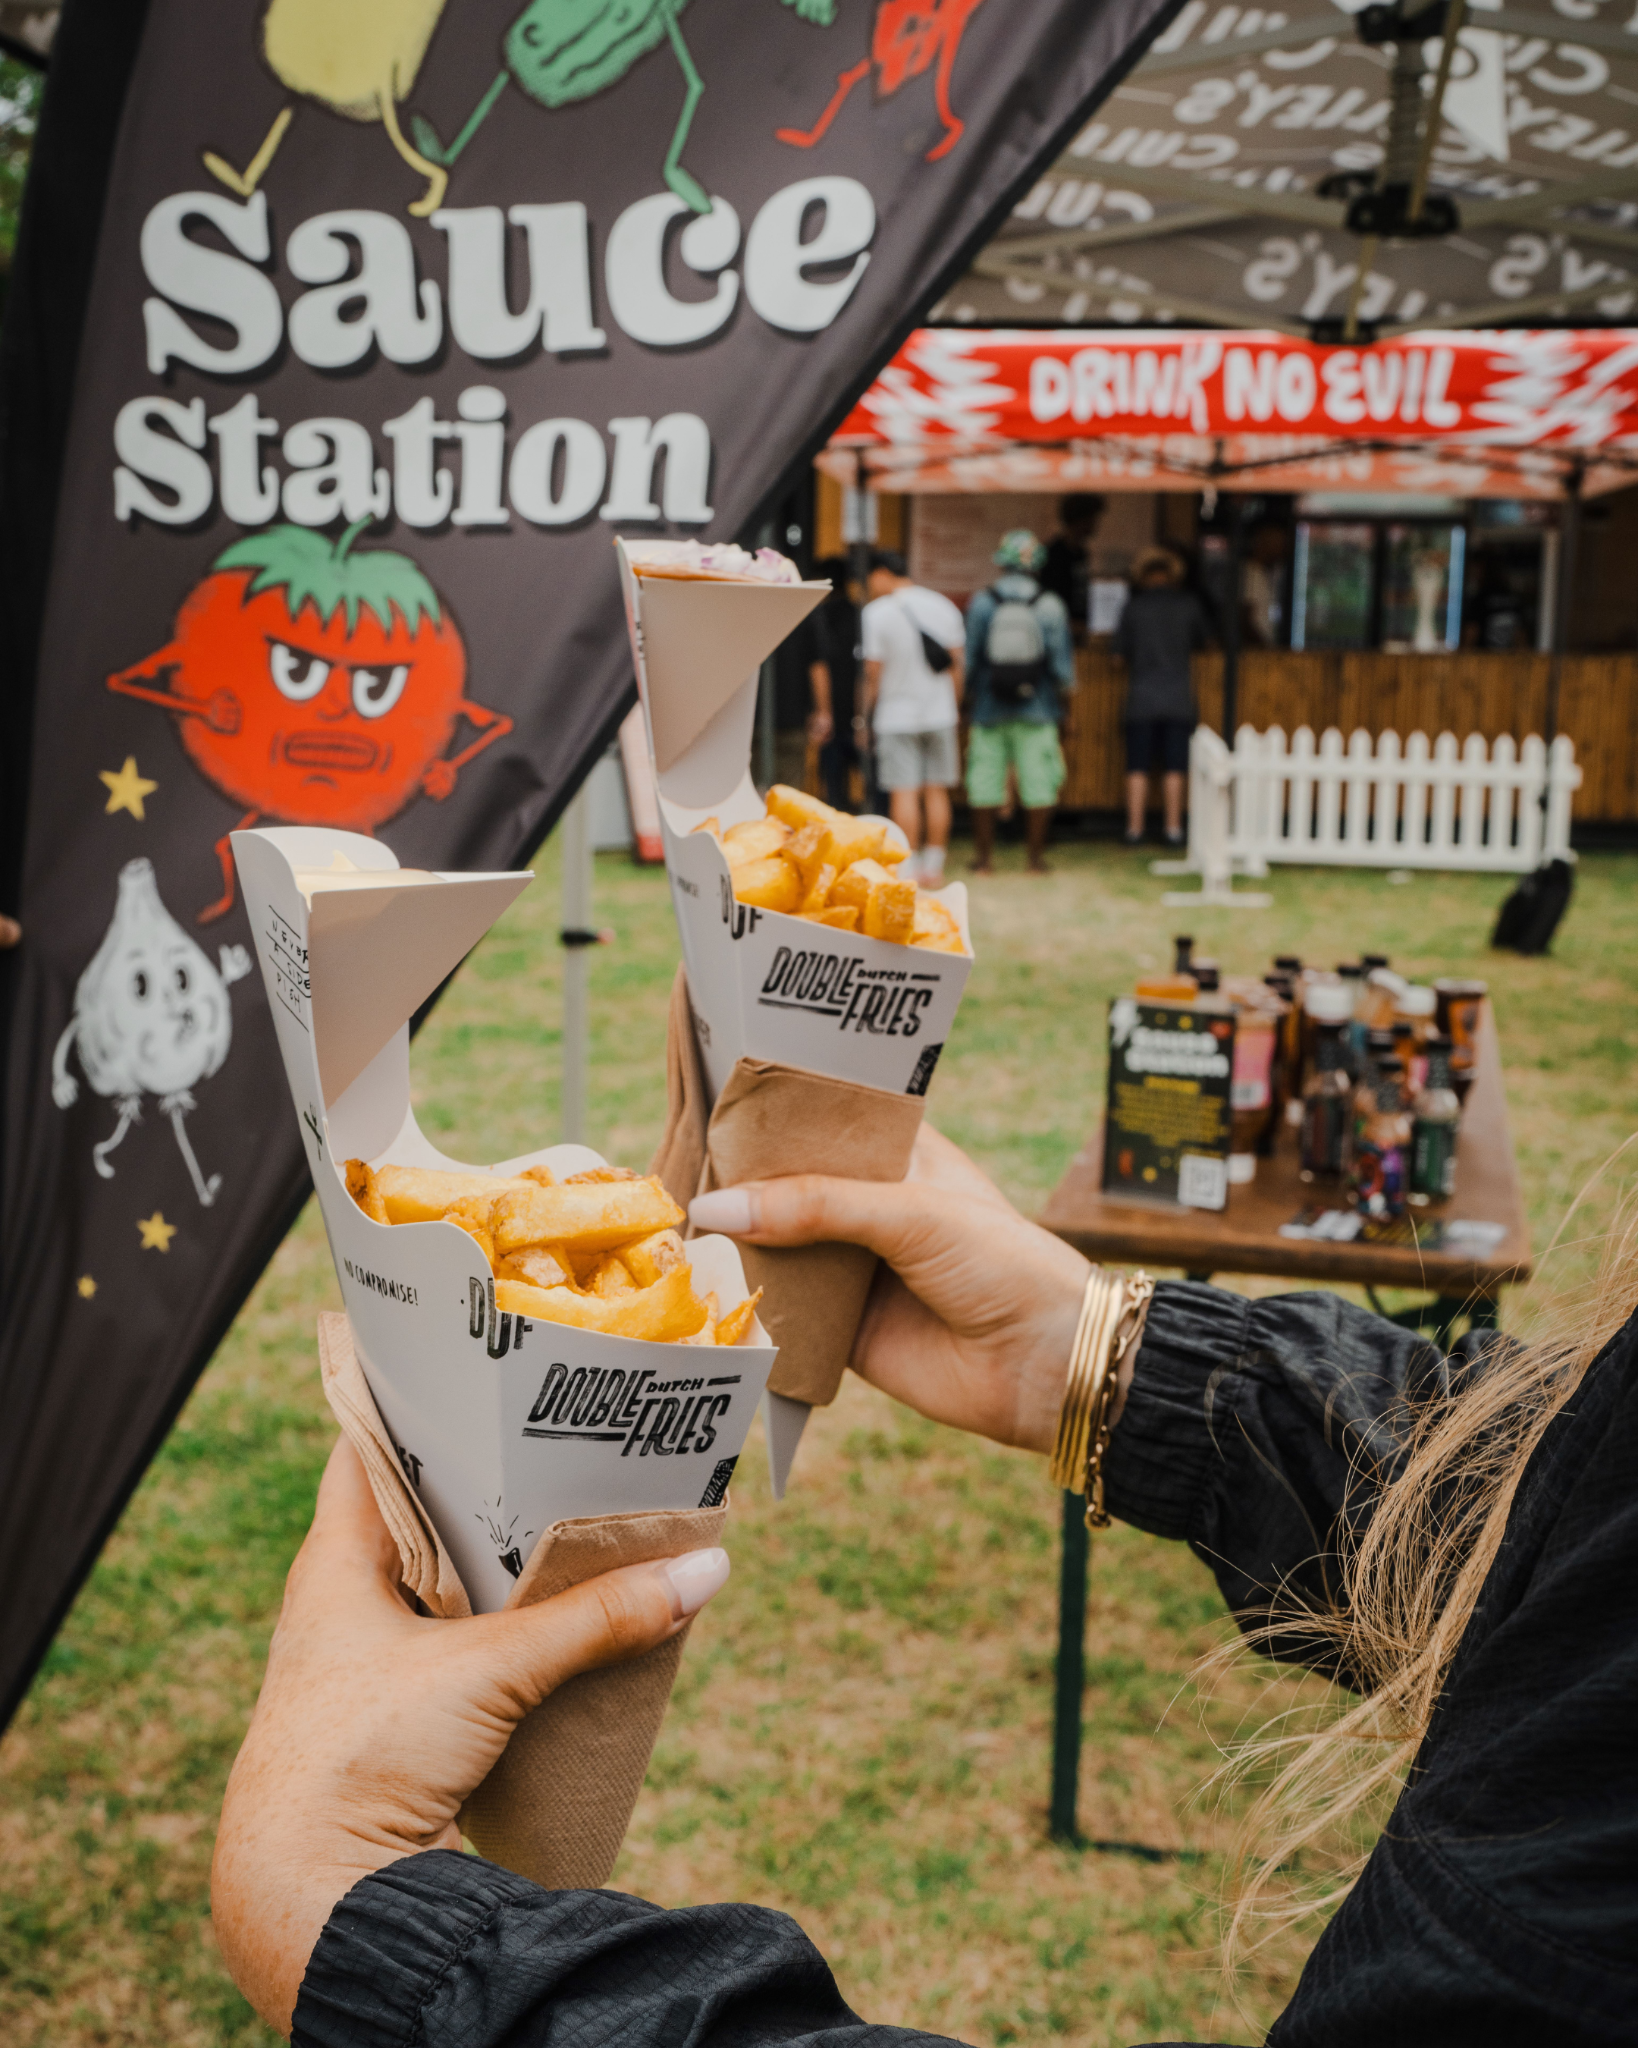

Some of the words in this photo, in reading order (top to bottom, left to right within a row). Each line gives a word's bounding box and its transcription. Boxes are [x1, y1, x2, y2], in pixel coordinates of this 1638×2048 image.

[139, 175, 877, 375] Sauce
[1029, 338, 1222, 434] DRINK
[1223, 347, 1317, 423] NO
[1321, 347, 1462, 428] EVIL
[112, 384, 717, 528] Station
[761, 946, 864, 1005] DOUBLE
[857, 968, 907, 981] DUTCH
[839, 983, 933, 1036] FRIES
[343, 1256, 354, 1279] NO
[355, 1264, 419, 1306] COMPROMISE!
[527, 1363, 657, 1428] DOUBLE
[645, 1378, 704, 1394] DUTCH
[621, 1394, 732, 1457] FRIES
